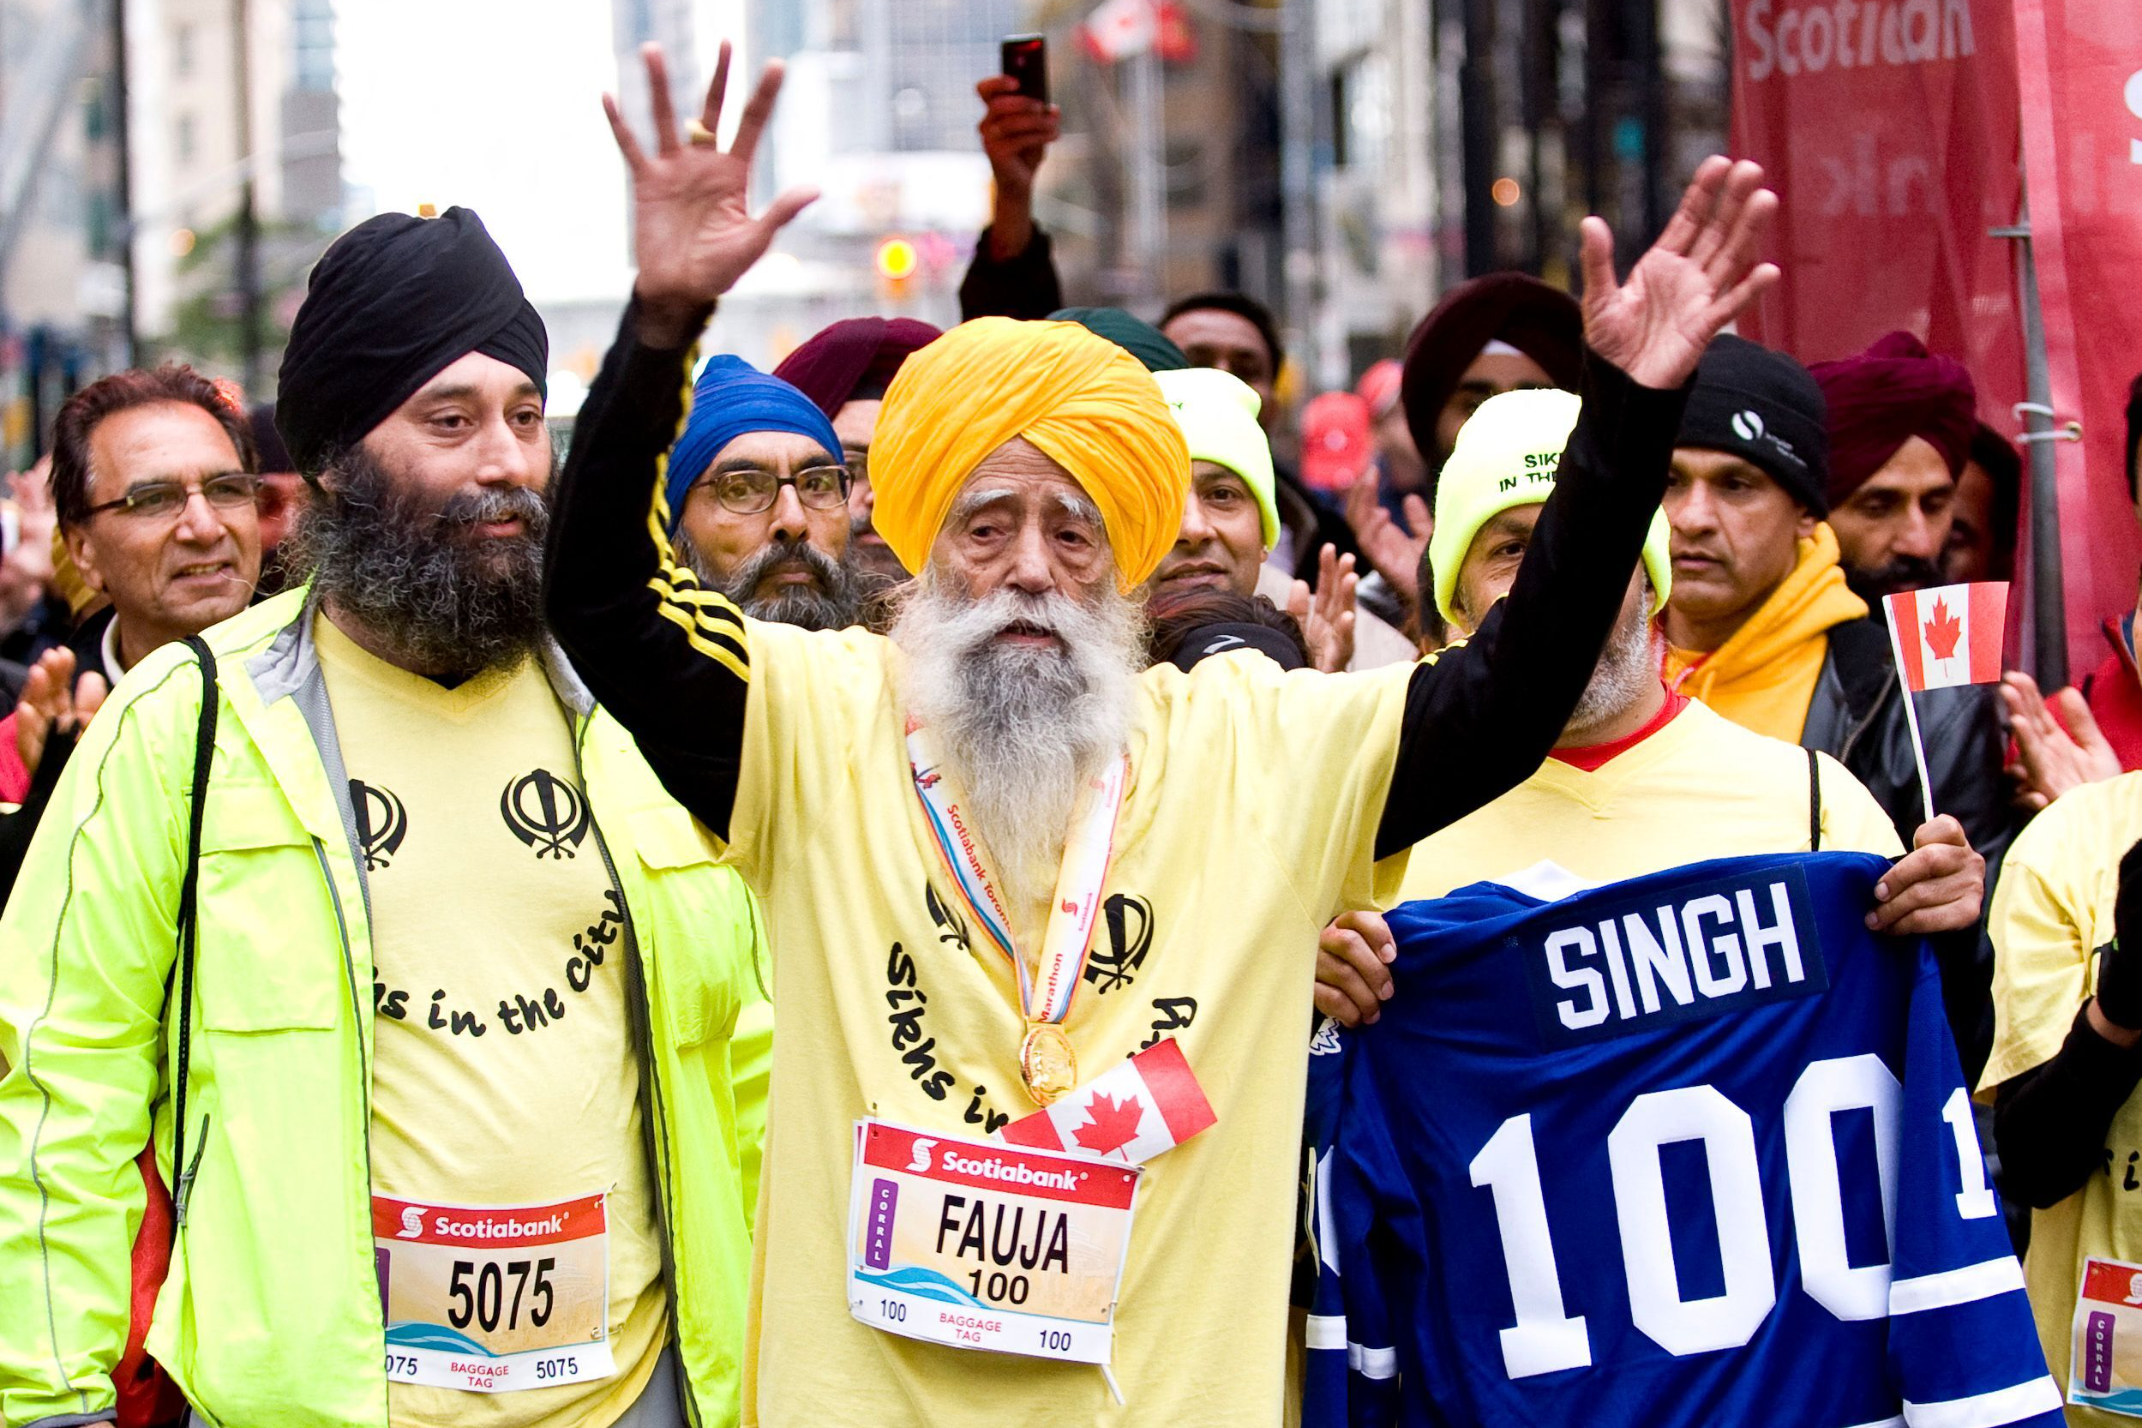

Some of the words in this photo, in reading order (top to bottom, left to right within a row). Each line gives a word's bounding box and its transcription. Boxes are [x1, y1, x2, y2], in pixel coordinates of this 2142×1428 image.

[1499, 476, 1517, 493] IN
[947, 804, 986, 881] Scotiabank
[984, 881, 1012, 934] Toront
[1543, 882, 1805, 1030] SINGH
[428, 989, 486, 1037] in
[498, 988, 565, 1035] the
[1037, 953, 1064, 1023] Marathon
[887, 941, 955, 1100] Sikhs
[942, 1151, 1078, 1192] Scotiabank
[435, 1214, 563, 1239] Scotiabank
[873, 1189, 890, 1262] CORRAL
[936, 1194, 1069, 1274] FAUJA
[1468, 1053, 1902, 1380] 100
[447, 1257, 556, 1333] 5075
[967, 1269, 1030, 1305] 100
[880, 1299, 907, 1323] 100
[939, 1312, 1002, 1333] BAGGAGE
[1039, 1331, 1072, 1352] 100
[955, 1329, 981, 1342] TAG
[2096, 1319, 2107, 1386] CORRAL
[450, 1362, 509, 1377] BAGGAGE
[536, 1357, 579, 1379] 5075
[467, 1376, 493, 1388] TAG
